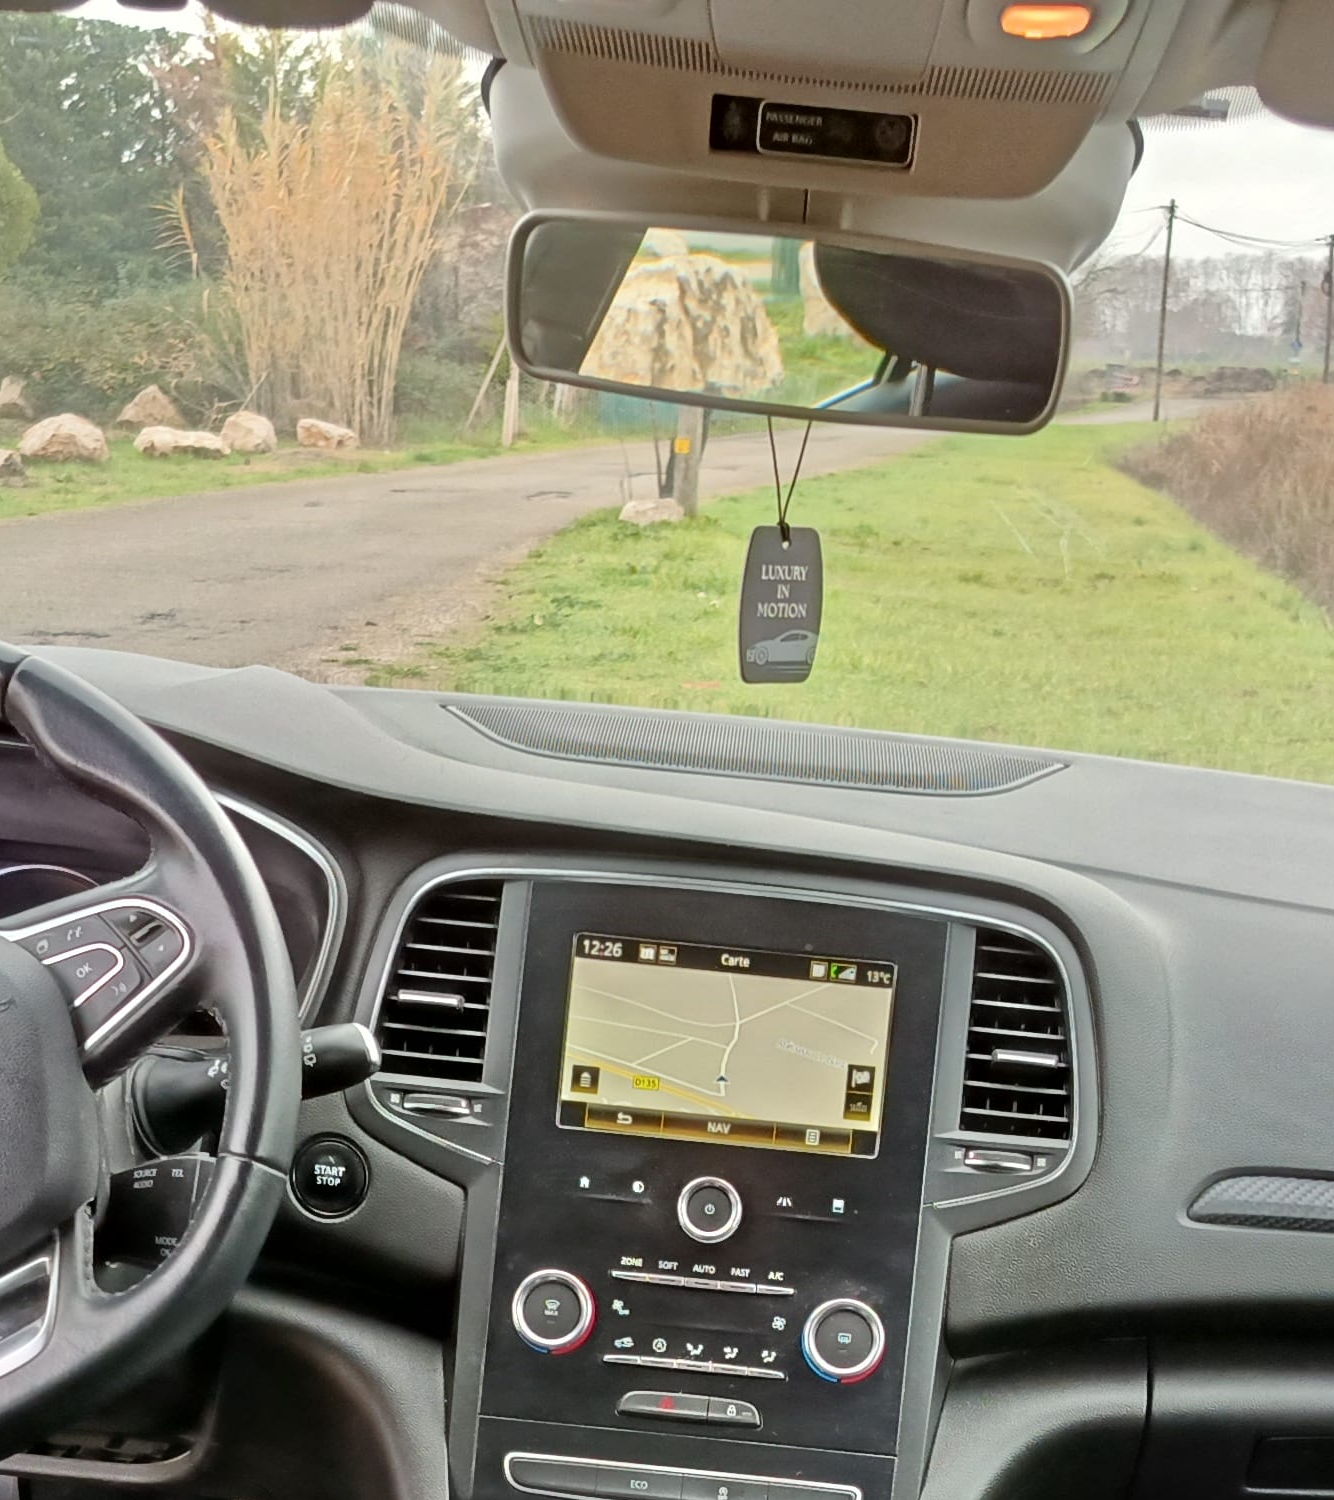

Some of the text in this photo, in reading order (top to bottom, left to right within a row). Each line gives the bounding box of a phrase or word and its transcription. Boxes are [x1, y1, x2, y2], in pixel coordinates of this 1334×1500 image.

[761, 564, 808, 581] LUXURY
[777, 584, 790, 599] IN
[757, 602, 807, 619] MOTION
[582, 938, 623, 958] 12:26
[720, 952, 751, 968] Carte
[76, 962, 93, 978] OK
[707, 1121, 732, 1134] NAV
[313, 1164, 346, 1177] START
[316, 1176, 341, 1187] STOP
[620, 1256, 644, 1268] ZONE
[692, 1263, 716, 1274] AUTO
[730, 1267, 751, 1278] FAST
[767, 1270, 785, 1281] A/C
[630, 1479, 648, 1490] ECO
